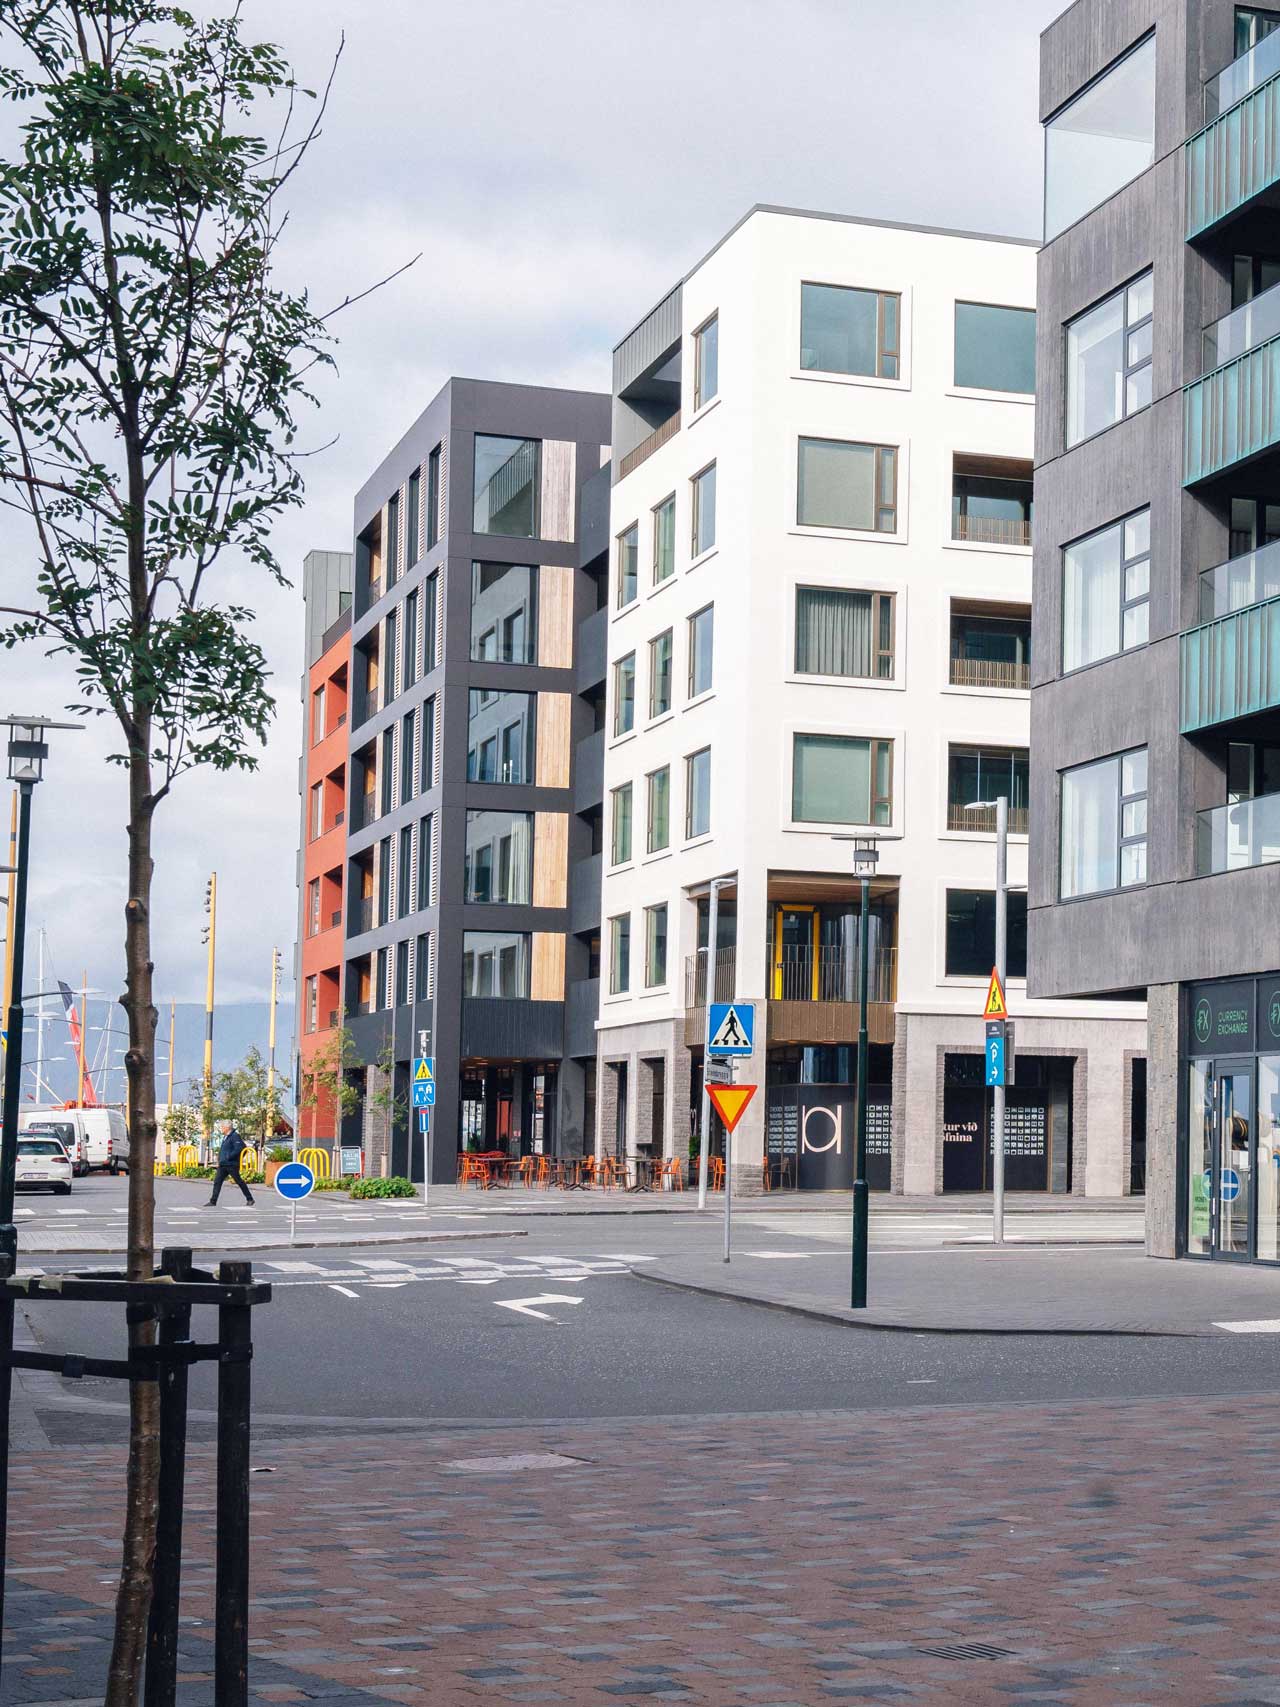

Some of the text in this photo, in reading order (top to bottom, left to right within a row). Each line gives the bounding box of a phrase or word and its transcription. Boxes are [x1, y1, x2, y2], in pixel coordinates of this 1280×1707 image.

[1197, 1009, 1209, 1030] FX
[1218, 1009, 1248, 1022] CURRENCY
[1217, 1022, 1248, 1035] EXCHANGE
[962, 1121, 978, 1132] við
